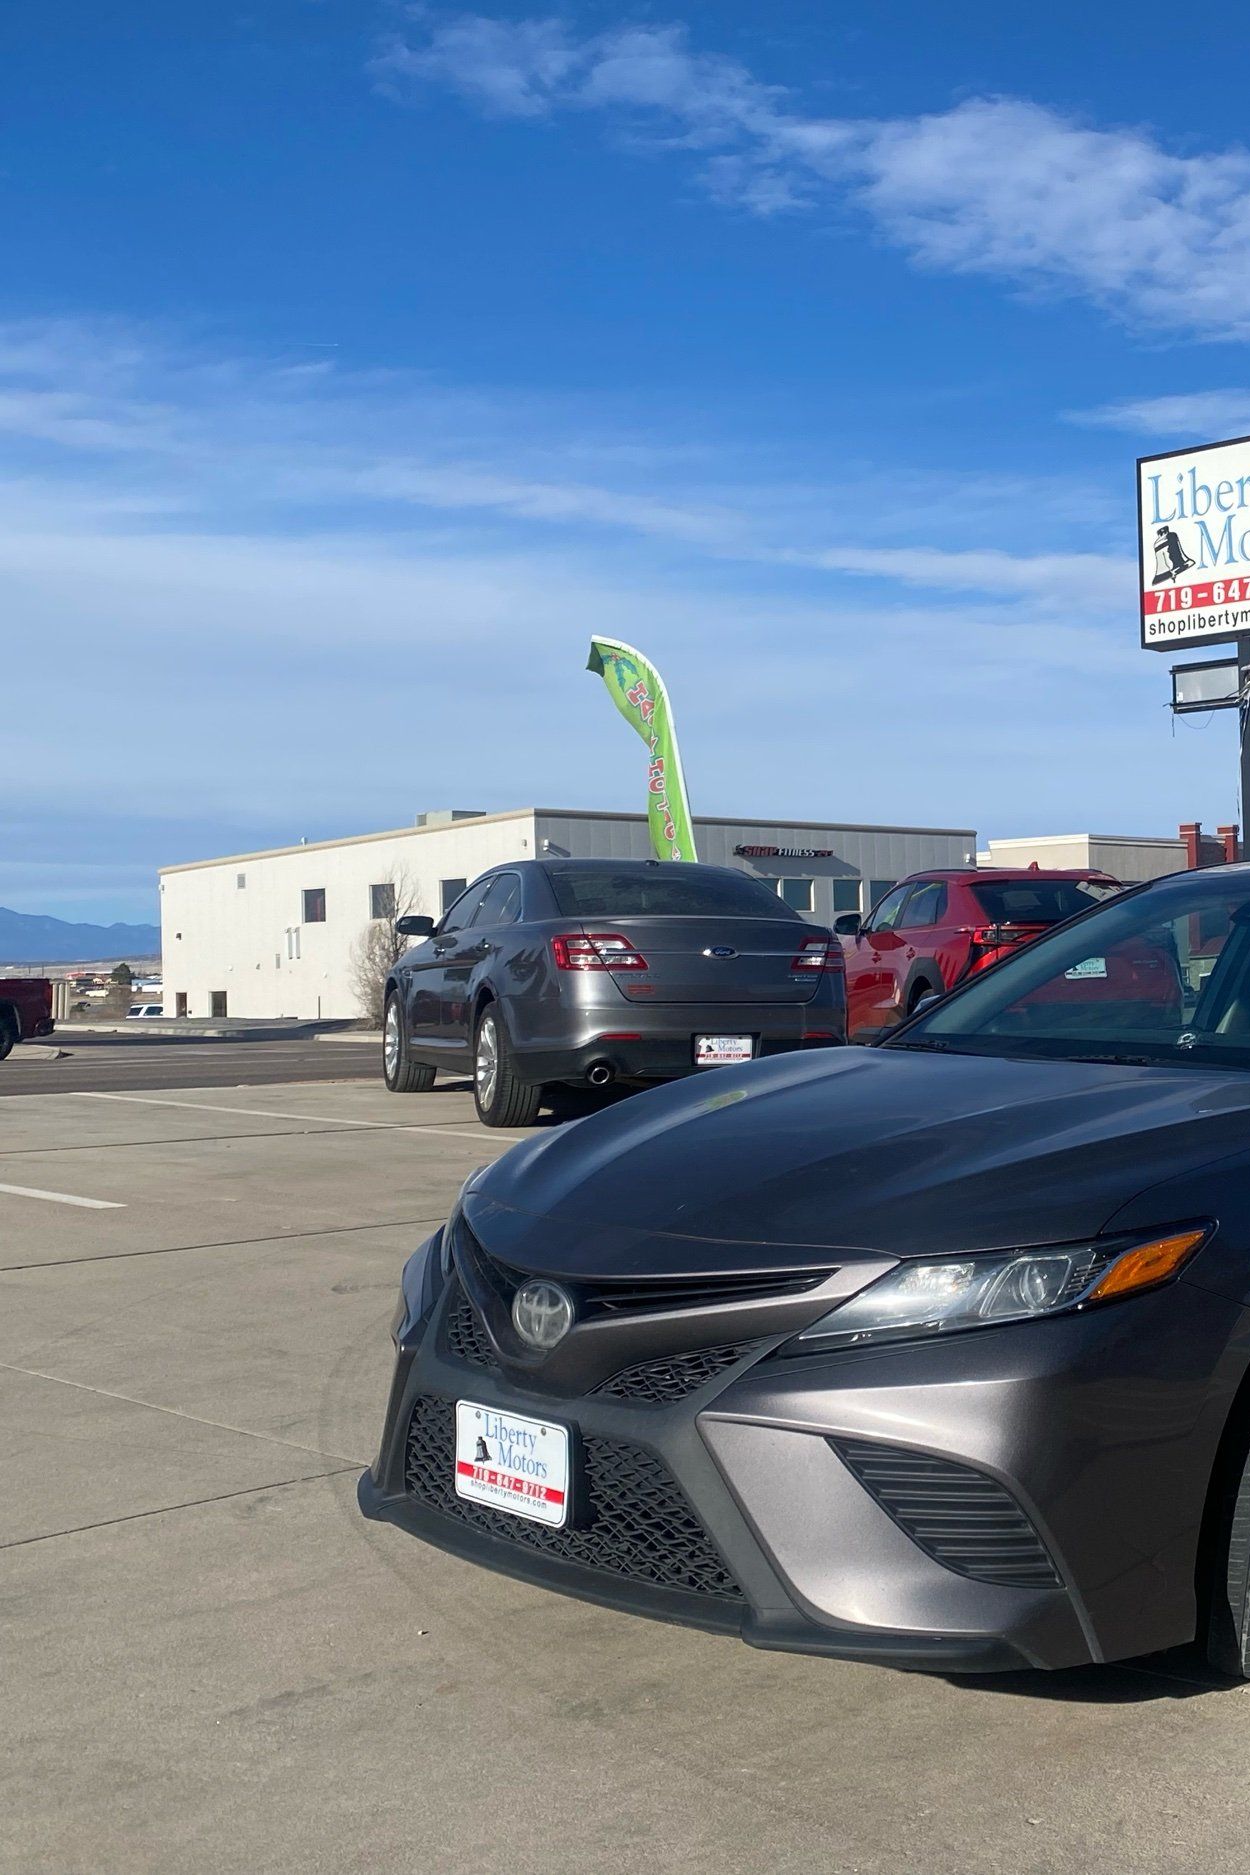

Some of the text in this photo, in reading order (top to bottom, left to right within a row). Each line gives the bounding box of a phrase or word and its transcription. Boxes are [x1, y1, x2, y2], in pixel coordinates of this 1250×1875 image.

[778, 848, 815, 857] FITNESS
[484, 1413, 537, 1455] Liberty
[497, 1442, 548, 1479] Motors
[470, 1479, 547, 1509] shoplibertymotors.com
